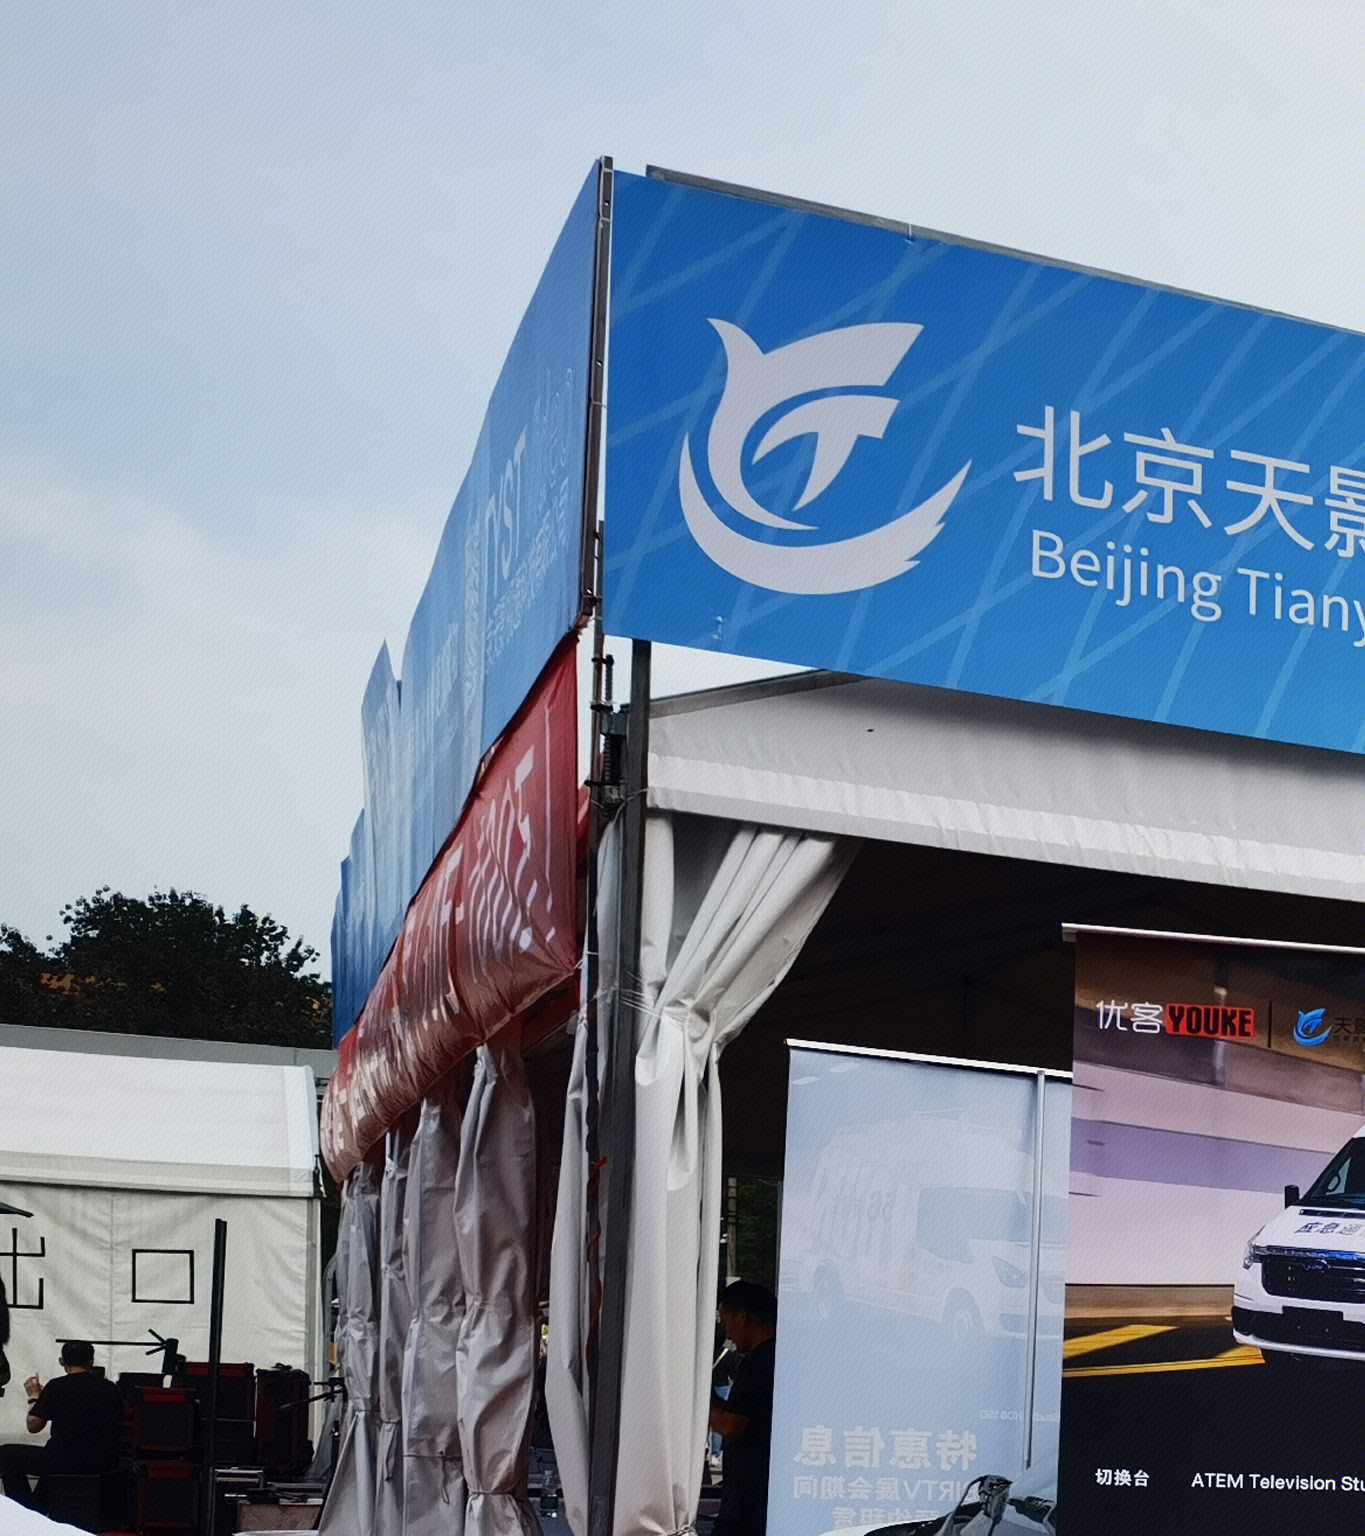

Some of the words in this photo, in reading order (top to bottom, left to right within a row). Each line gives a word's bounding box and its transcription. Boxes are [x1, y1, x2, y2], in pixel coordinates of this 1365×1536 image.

[1033, 530, 1223, 621] Beijing
[1096, 1000, 1164, 1034] 优客
[1168, 1005, 1252, 1037] YOUKE
[1095, 1469, 1149, 1487] 切换台
[1191, 1473, 1243, 1488] ATEM
[1249, 1474, 1336, 1490] Television
